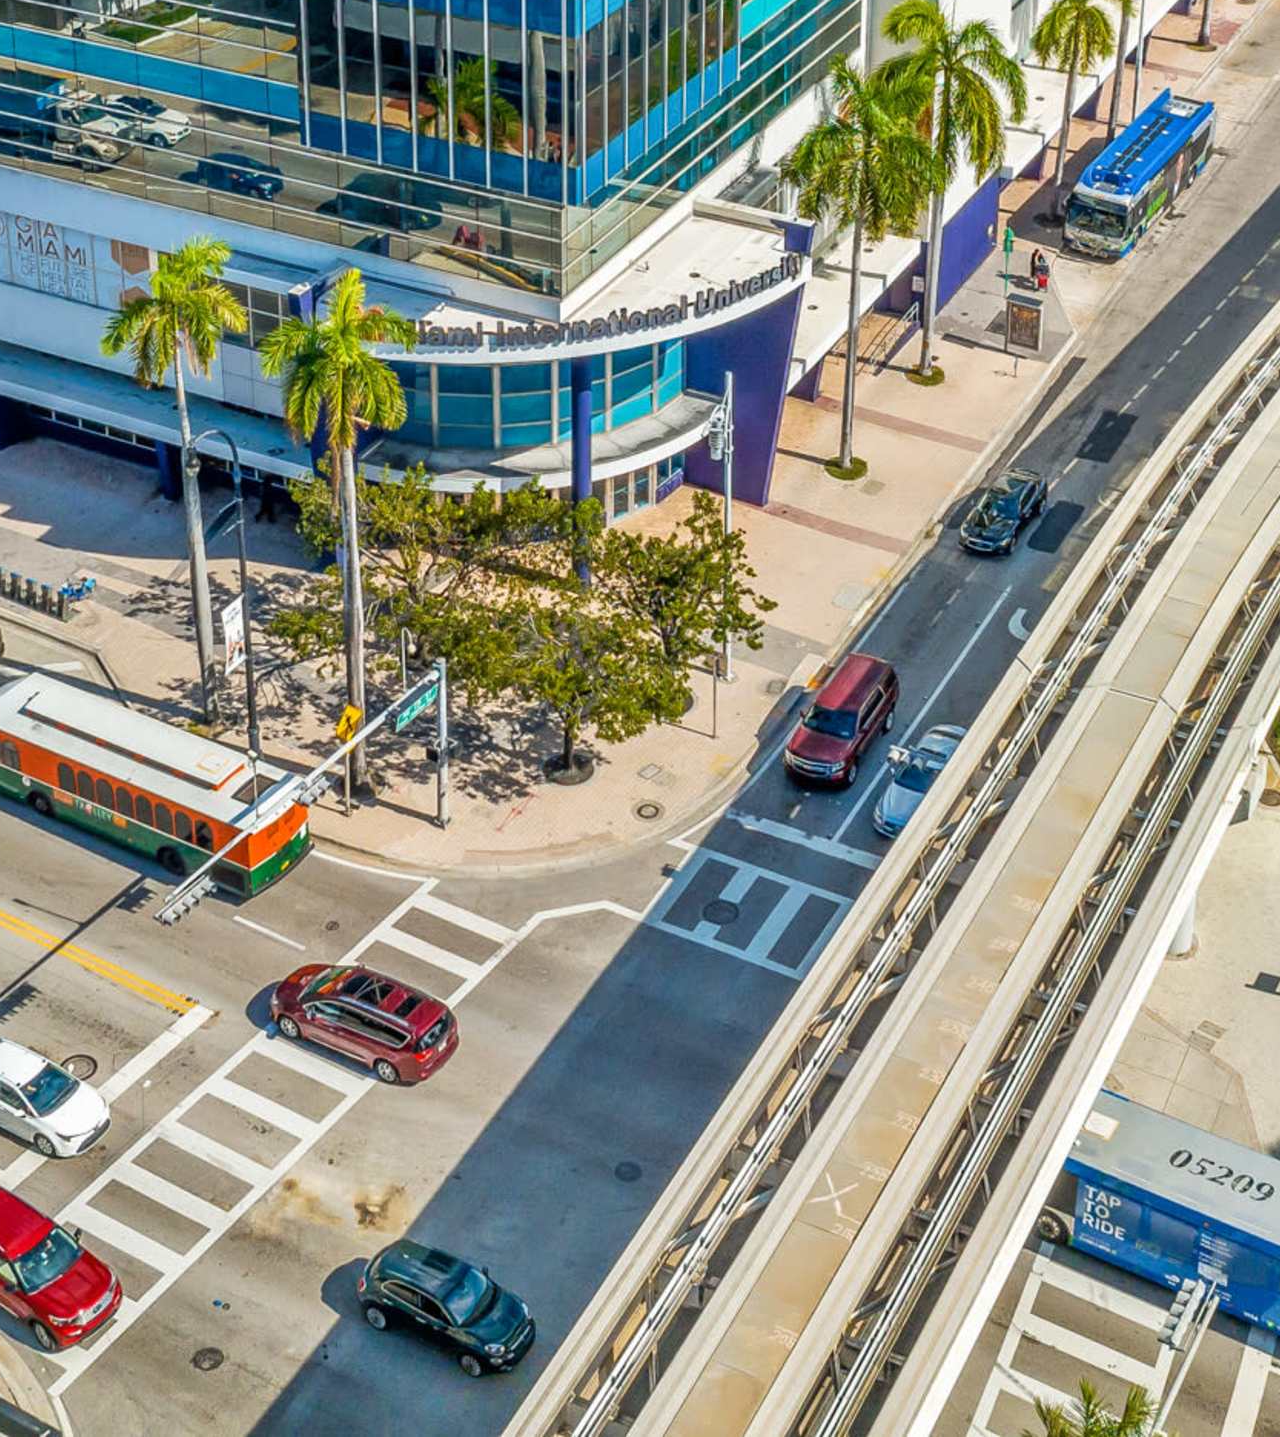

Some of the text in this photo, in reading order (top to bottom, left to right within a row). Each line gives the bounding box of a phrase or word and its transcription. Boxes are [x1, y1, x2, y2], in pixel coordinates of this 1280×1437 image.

[14, 214, 60, 241] GIA
[16, 231, 88, 268] MIAMI
[407, 253, 802, 348] iami International University
[1168, 1148, 1276, 1202] 05209
[1083, 1198, 1111, 1220] TO
[1084, 1183, 1122, 1209] TAP
[1081, 1212, 1128, 1242] RIDE
